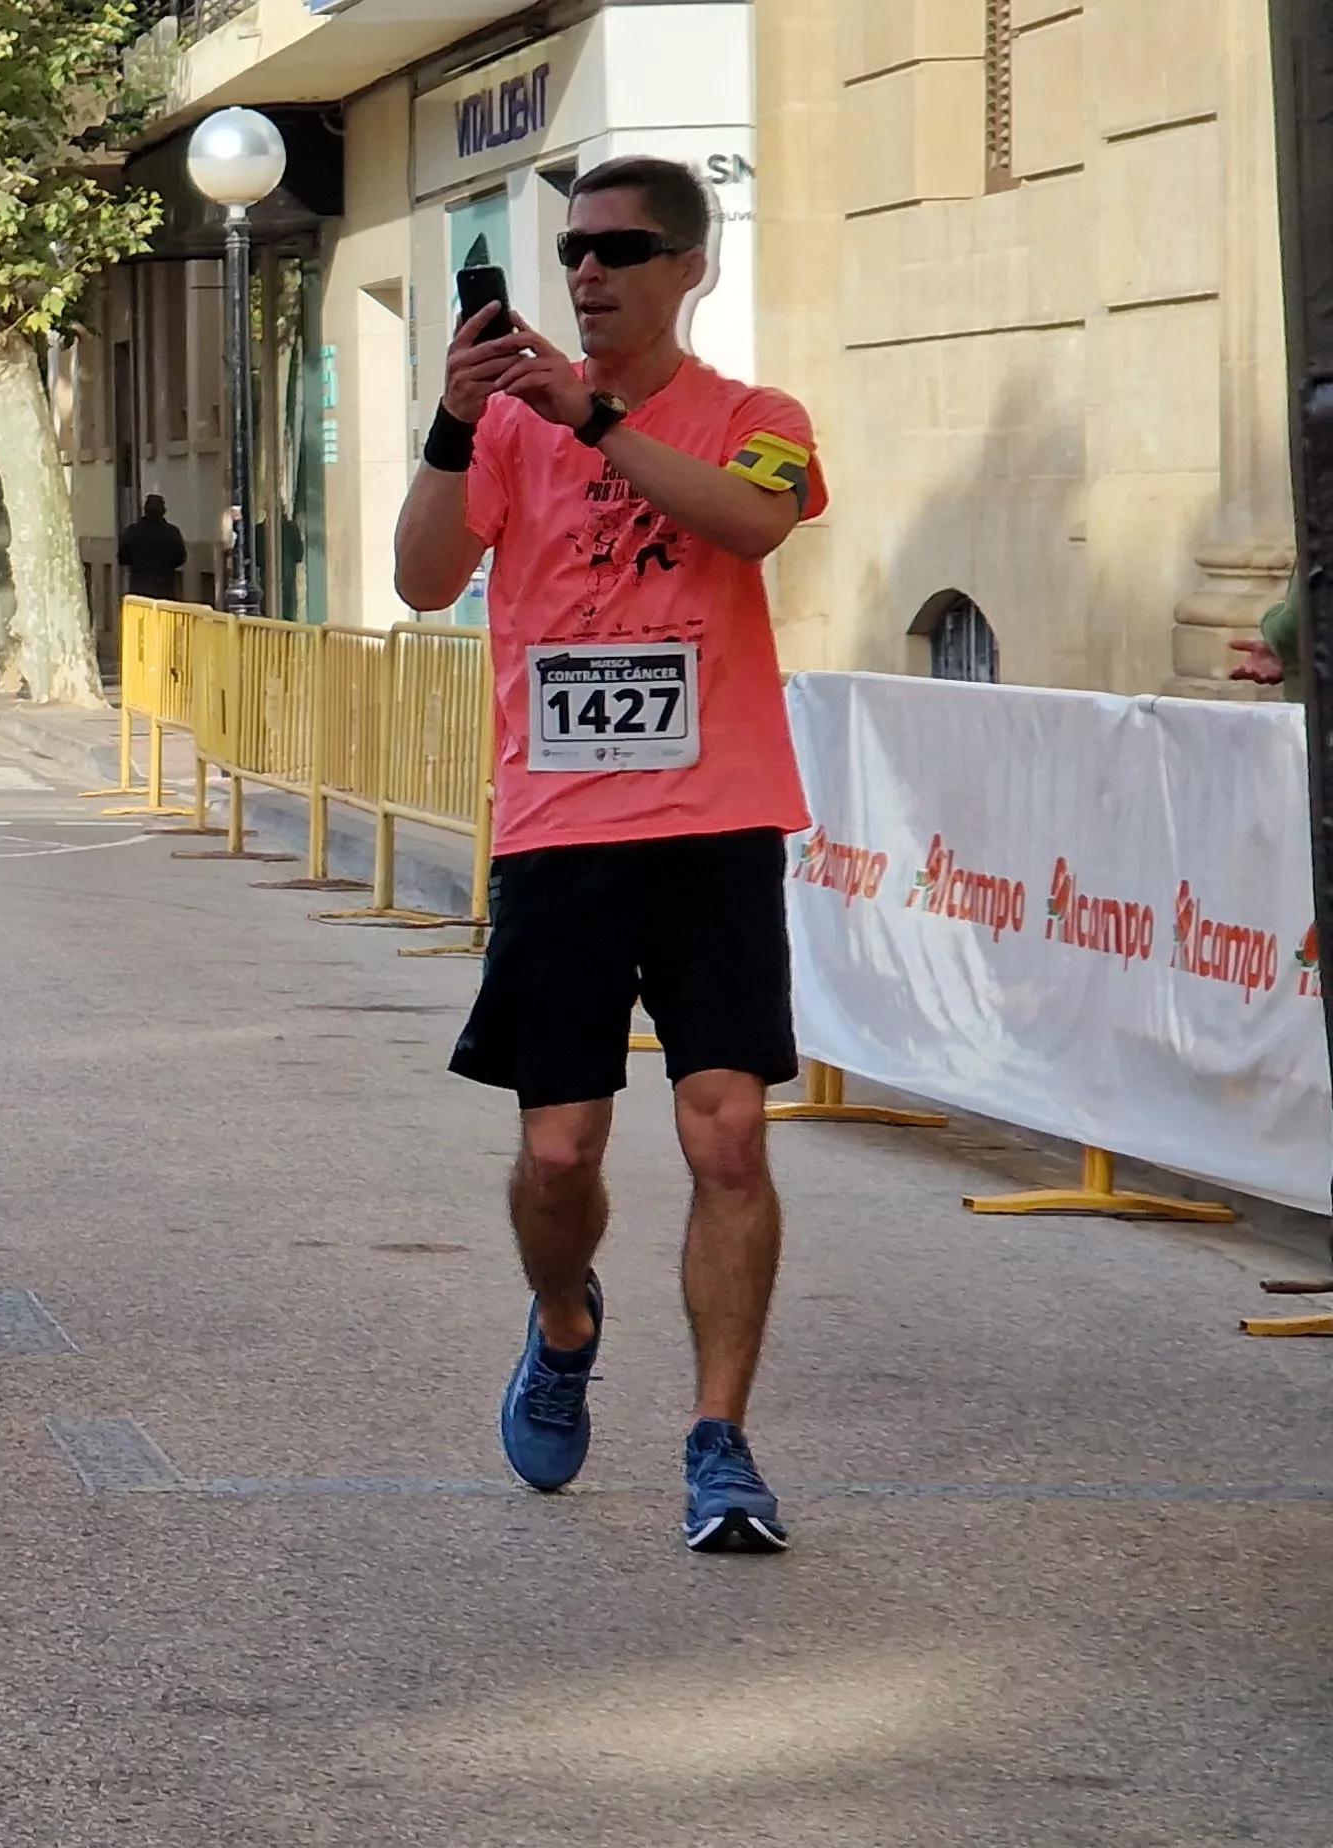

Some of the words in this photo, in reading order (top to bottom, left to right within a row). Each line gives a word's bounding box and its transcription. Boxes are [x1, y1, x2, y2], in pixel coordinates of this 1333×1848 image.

[455, 62, 549, 157] VITALDENT
[547, 669, 602, 682] CONTRA
[604, 670, 621, 681] EL
[622, 665, 679, 680] CÁNCER
[590, 659, 632, 668] HUESCA
[548, 688, 681, 734] 1427
[905, 833, 1025, 943] Alcampo
[1044, 856, 1155, 972] Alcampo
[1170, 879, 1278, 1004] Alcampo
